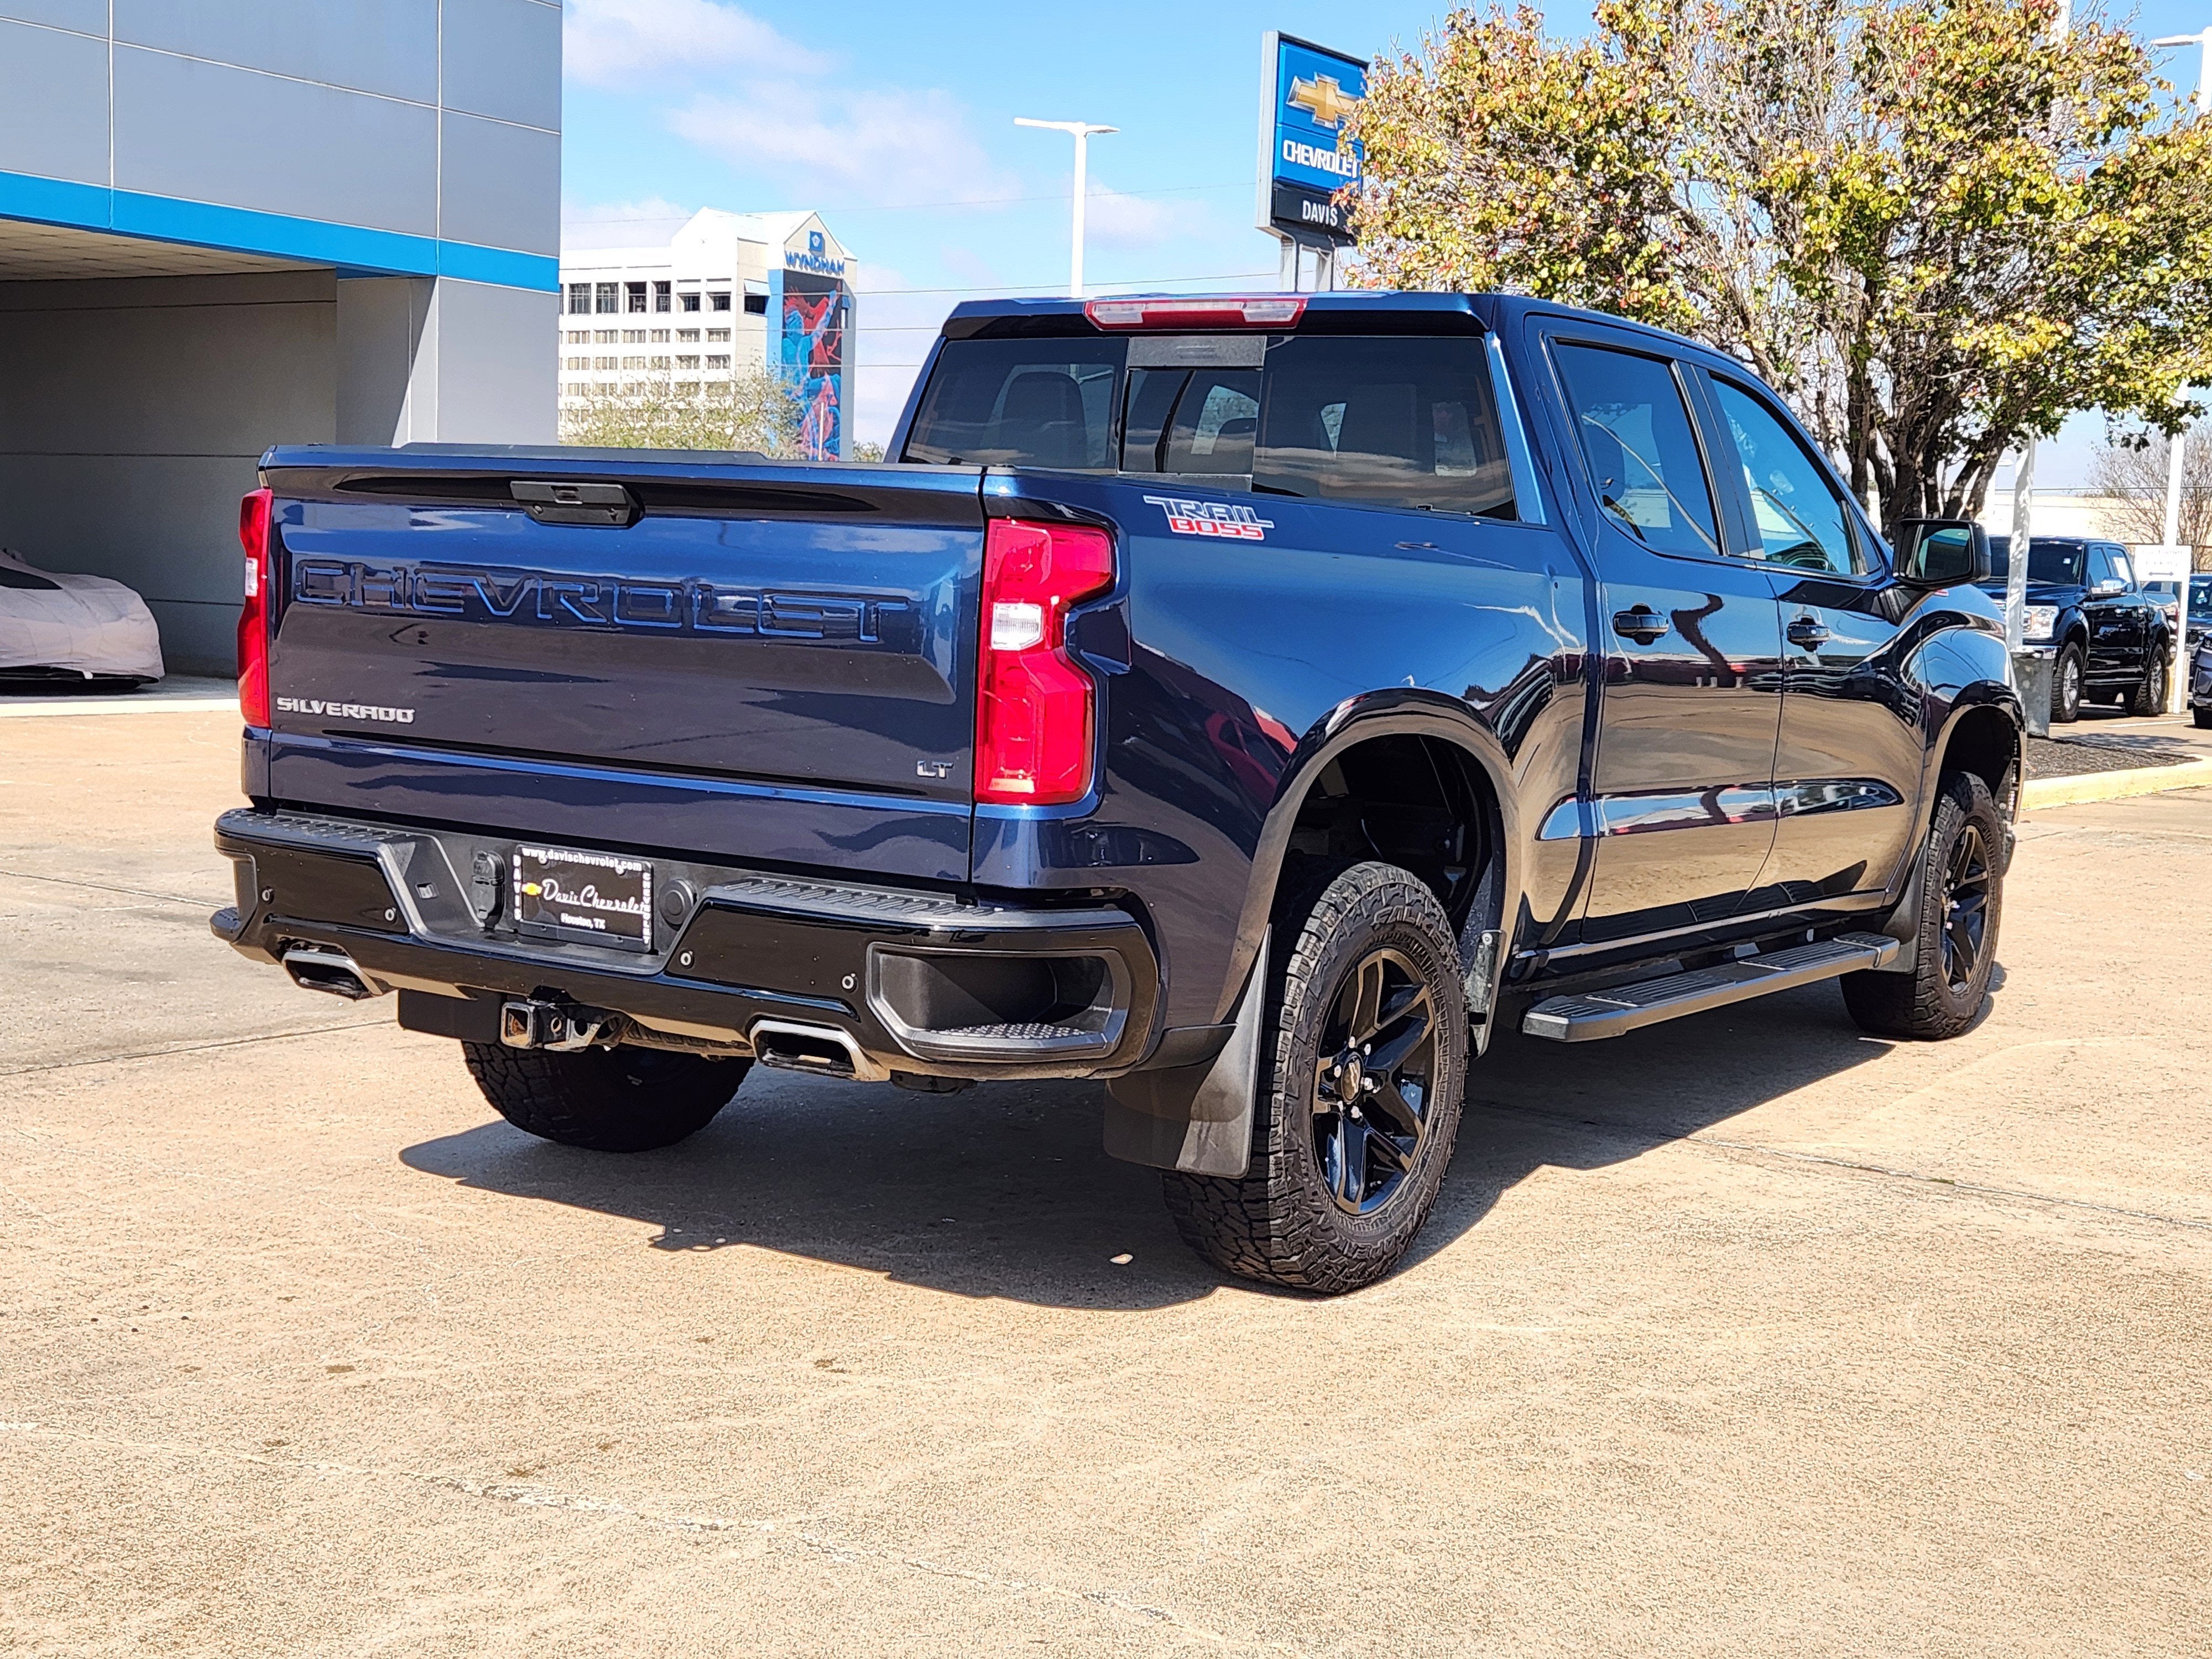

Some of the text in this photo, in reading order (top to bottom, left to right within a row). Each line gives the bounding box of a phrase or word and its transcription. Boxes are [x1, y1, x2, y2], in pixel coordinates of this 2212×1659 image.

[1283, 139, 1358, 178] CHEVROLET
[1302, 200, 1338, 227] DAVIS
[785, 251, 844, 274] WYNDHAM
[1142, 494, 1275, 529] TRAIL
[1169, 517, 1265, 541] BOSS
[295, 559, 910, 642] CHEVROLET
[276, 696, 415, 723] SILVERADO
[917, 760, 954, 779] LT
[521, 847, 643, 872] www.davischevrolet.com
[513, 854, 522, 920] DAVIS
[542, 879, 581, 905] Davis
[643, 872, 651, 944] CHEVROLET
[593, 917, 606, 930] TX
